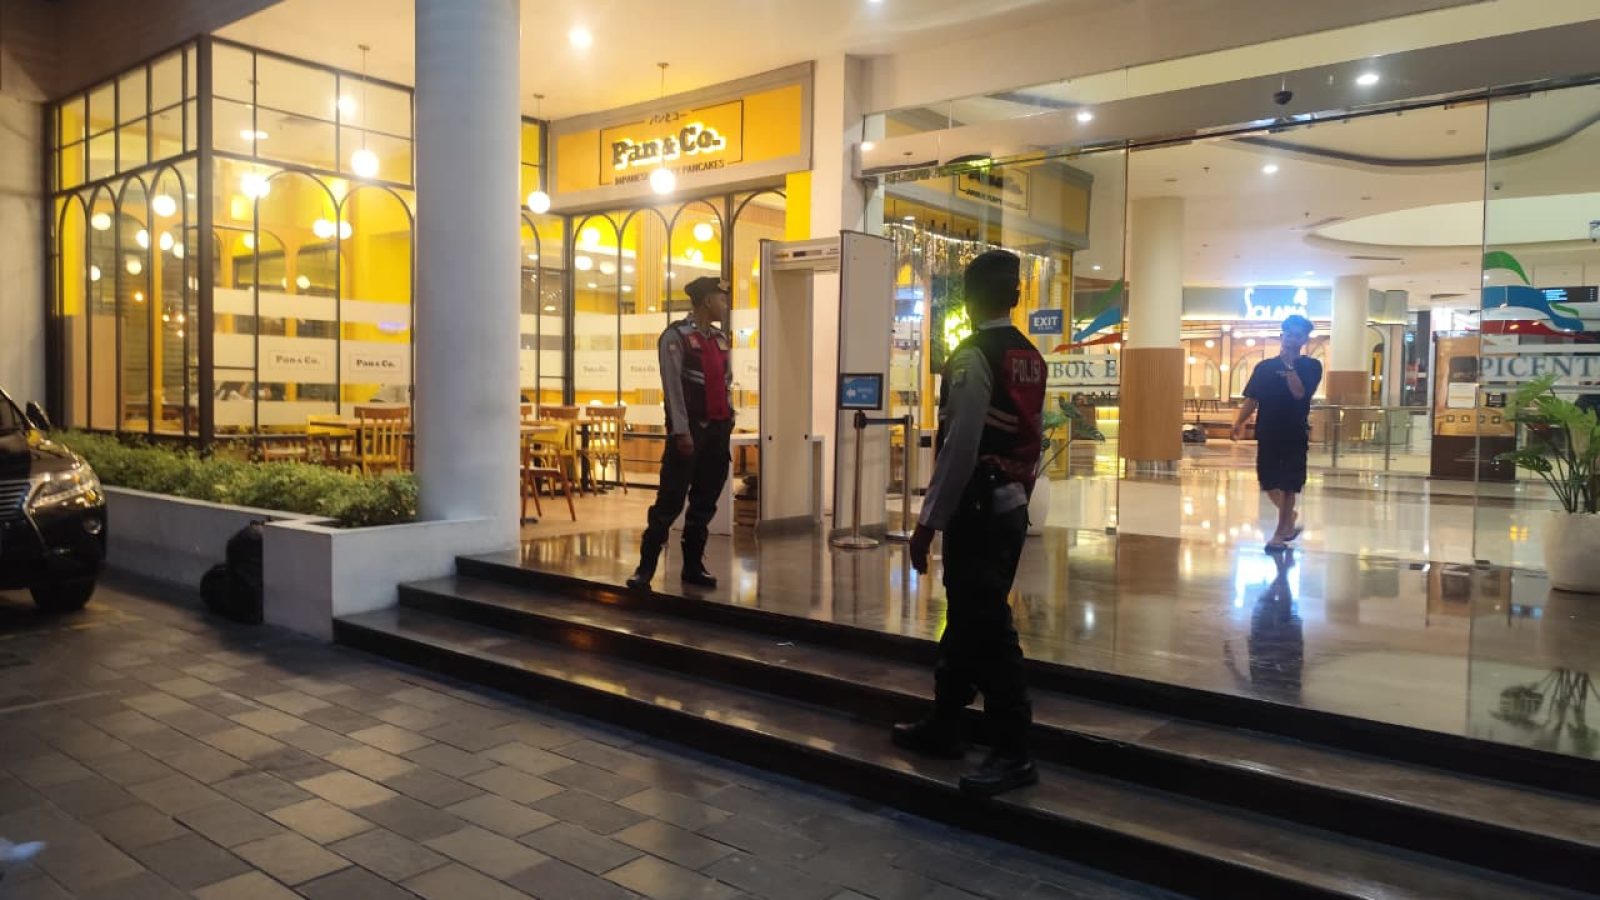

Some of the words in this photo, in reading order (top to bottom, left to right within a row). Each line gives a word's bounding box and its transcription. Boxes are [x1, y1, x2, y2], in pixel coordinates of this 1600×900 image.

[612, 141, 658, 166] Pan
[662, 138, 676, 155] &
[680, 126, 721, 152] Co.
[1033, 316, 1058, 327] EXIT
[356, 359, 374, 367] Pan
[1047, 361, 1095, 378] BOK
